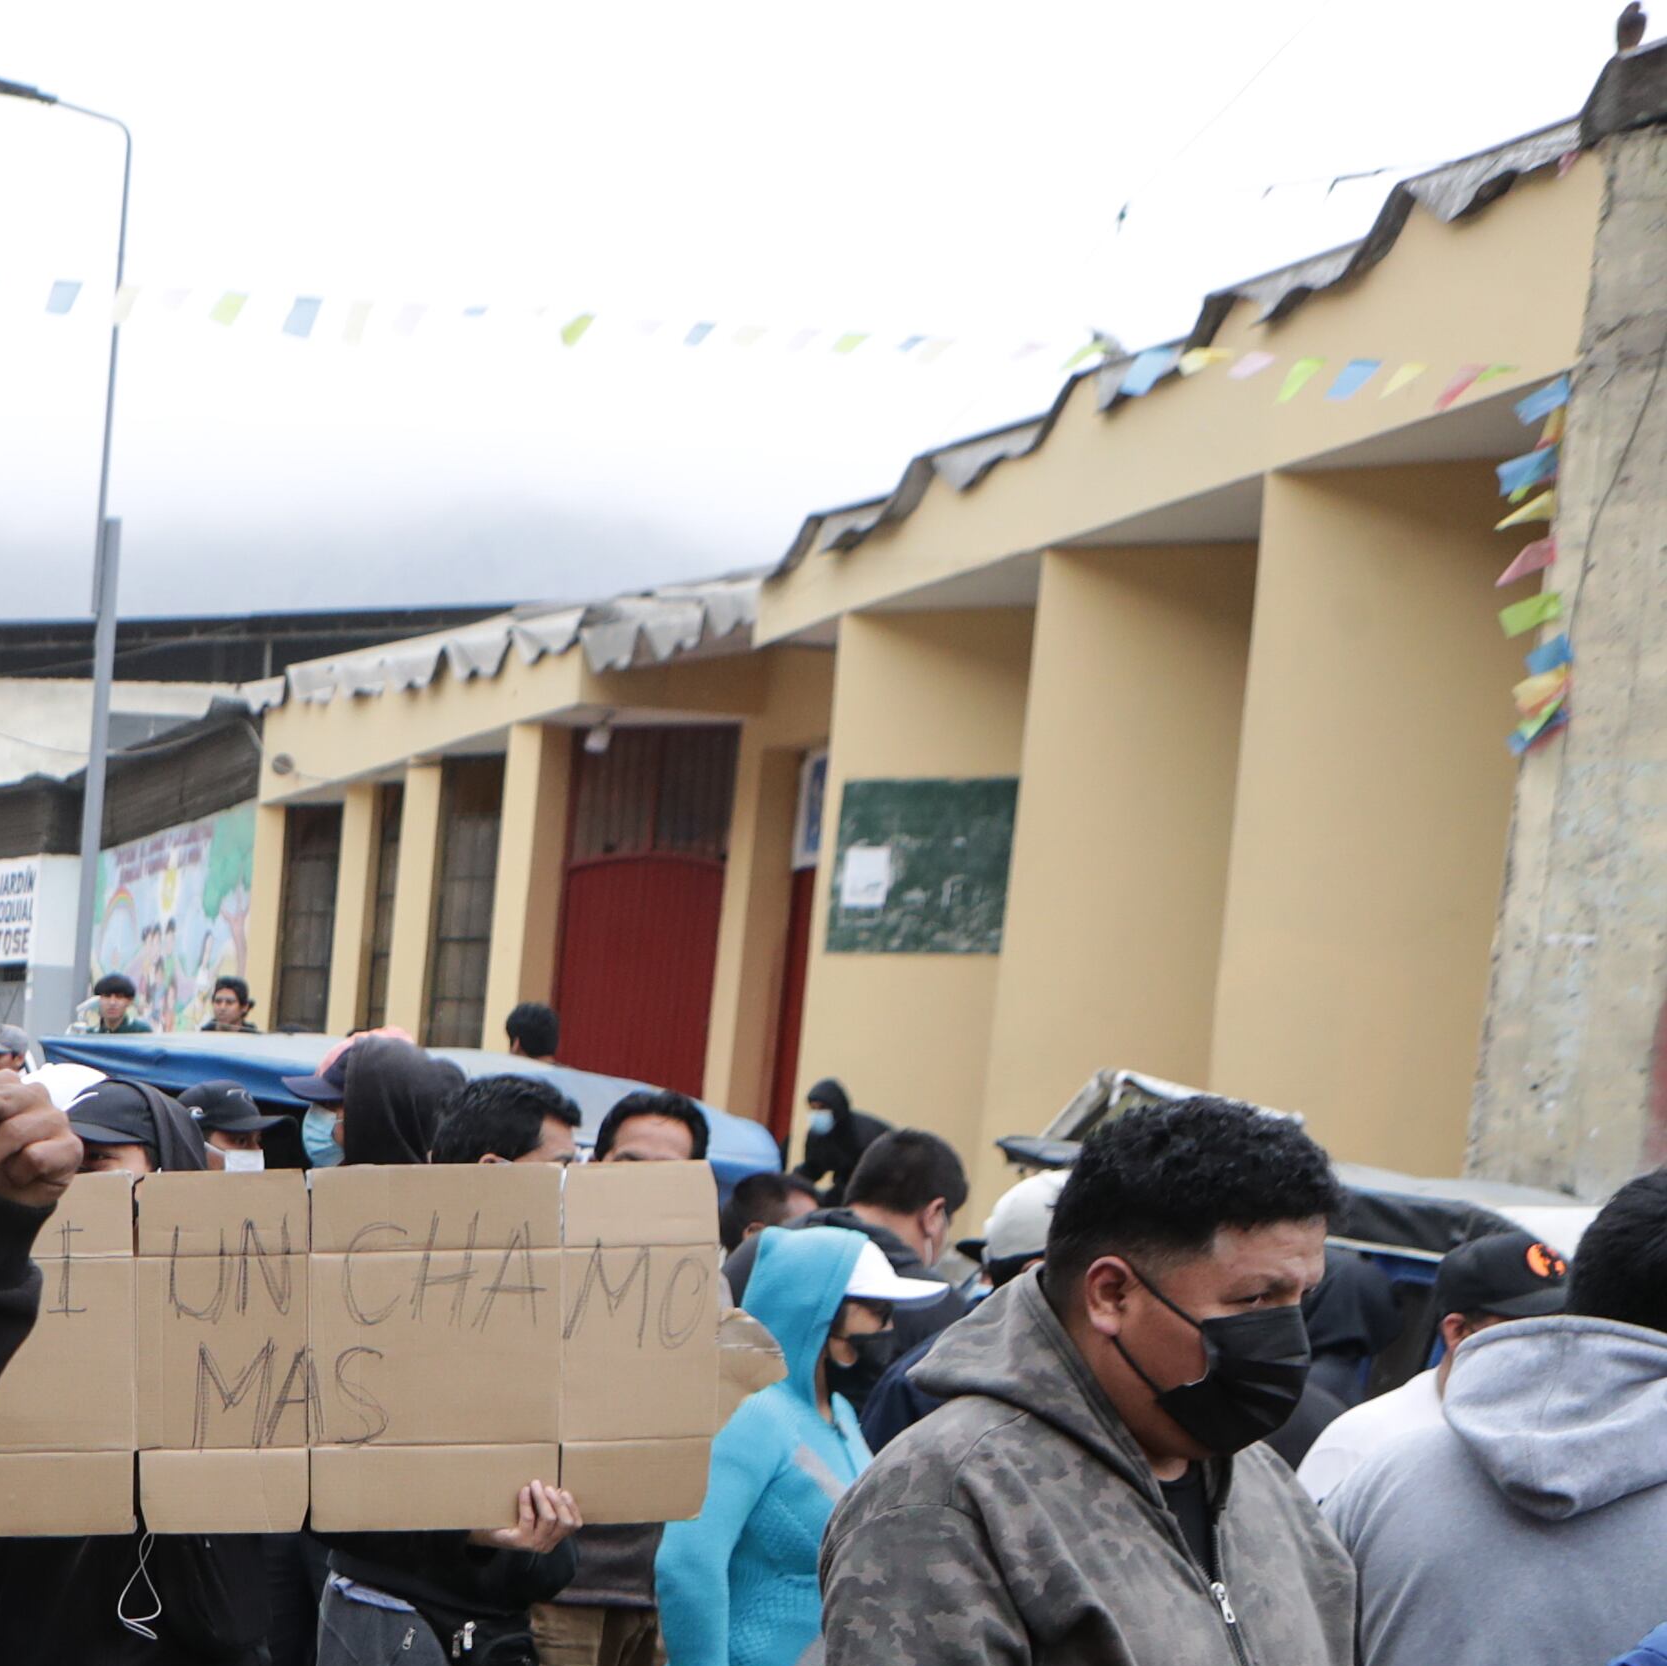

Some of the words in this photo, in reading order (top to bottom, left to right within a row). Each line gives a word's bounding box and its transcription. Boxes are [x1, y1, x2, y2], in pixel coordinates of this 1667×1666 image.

[168, 1214, 293, 1325] UN
[343, 1210, 710, 1350] CHAMO
[193, 1336, 391, 1451] MAS
